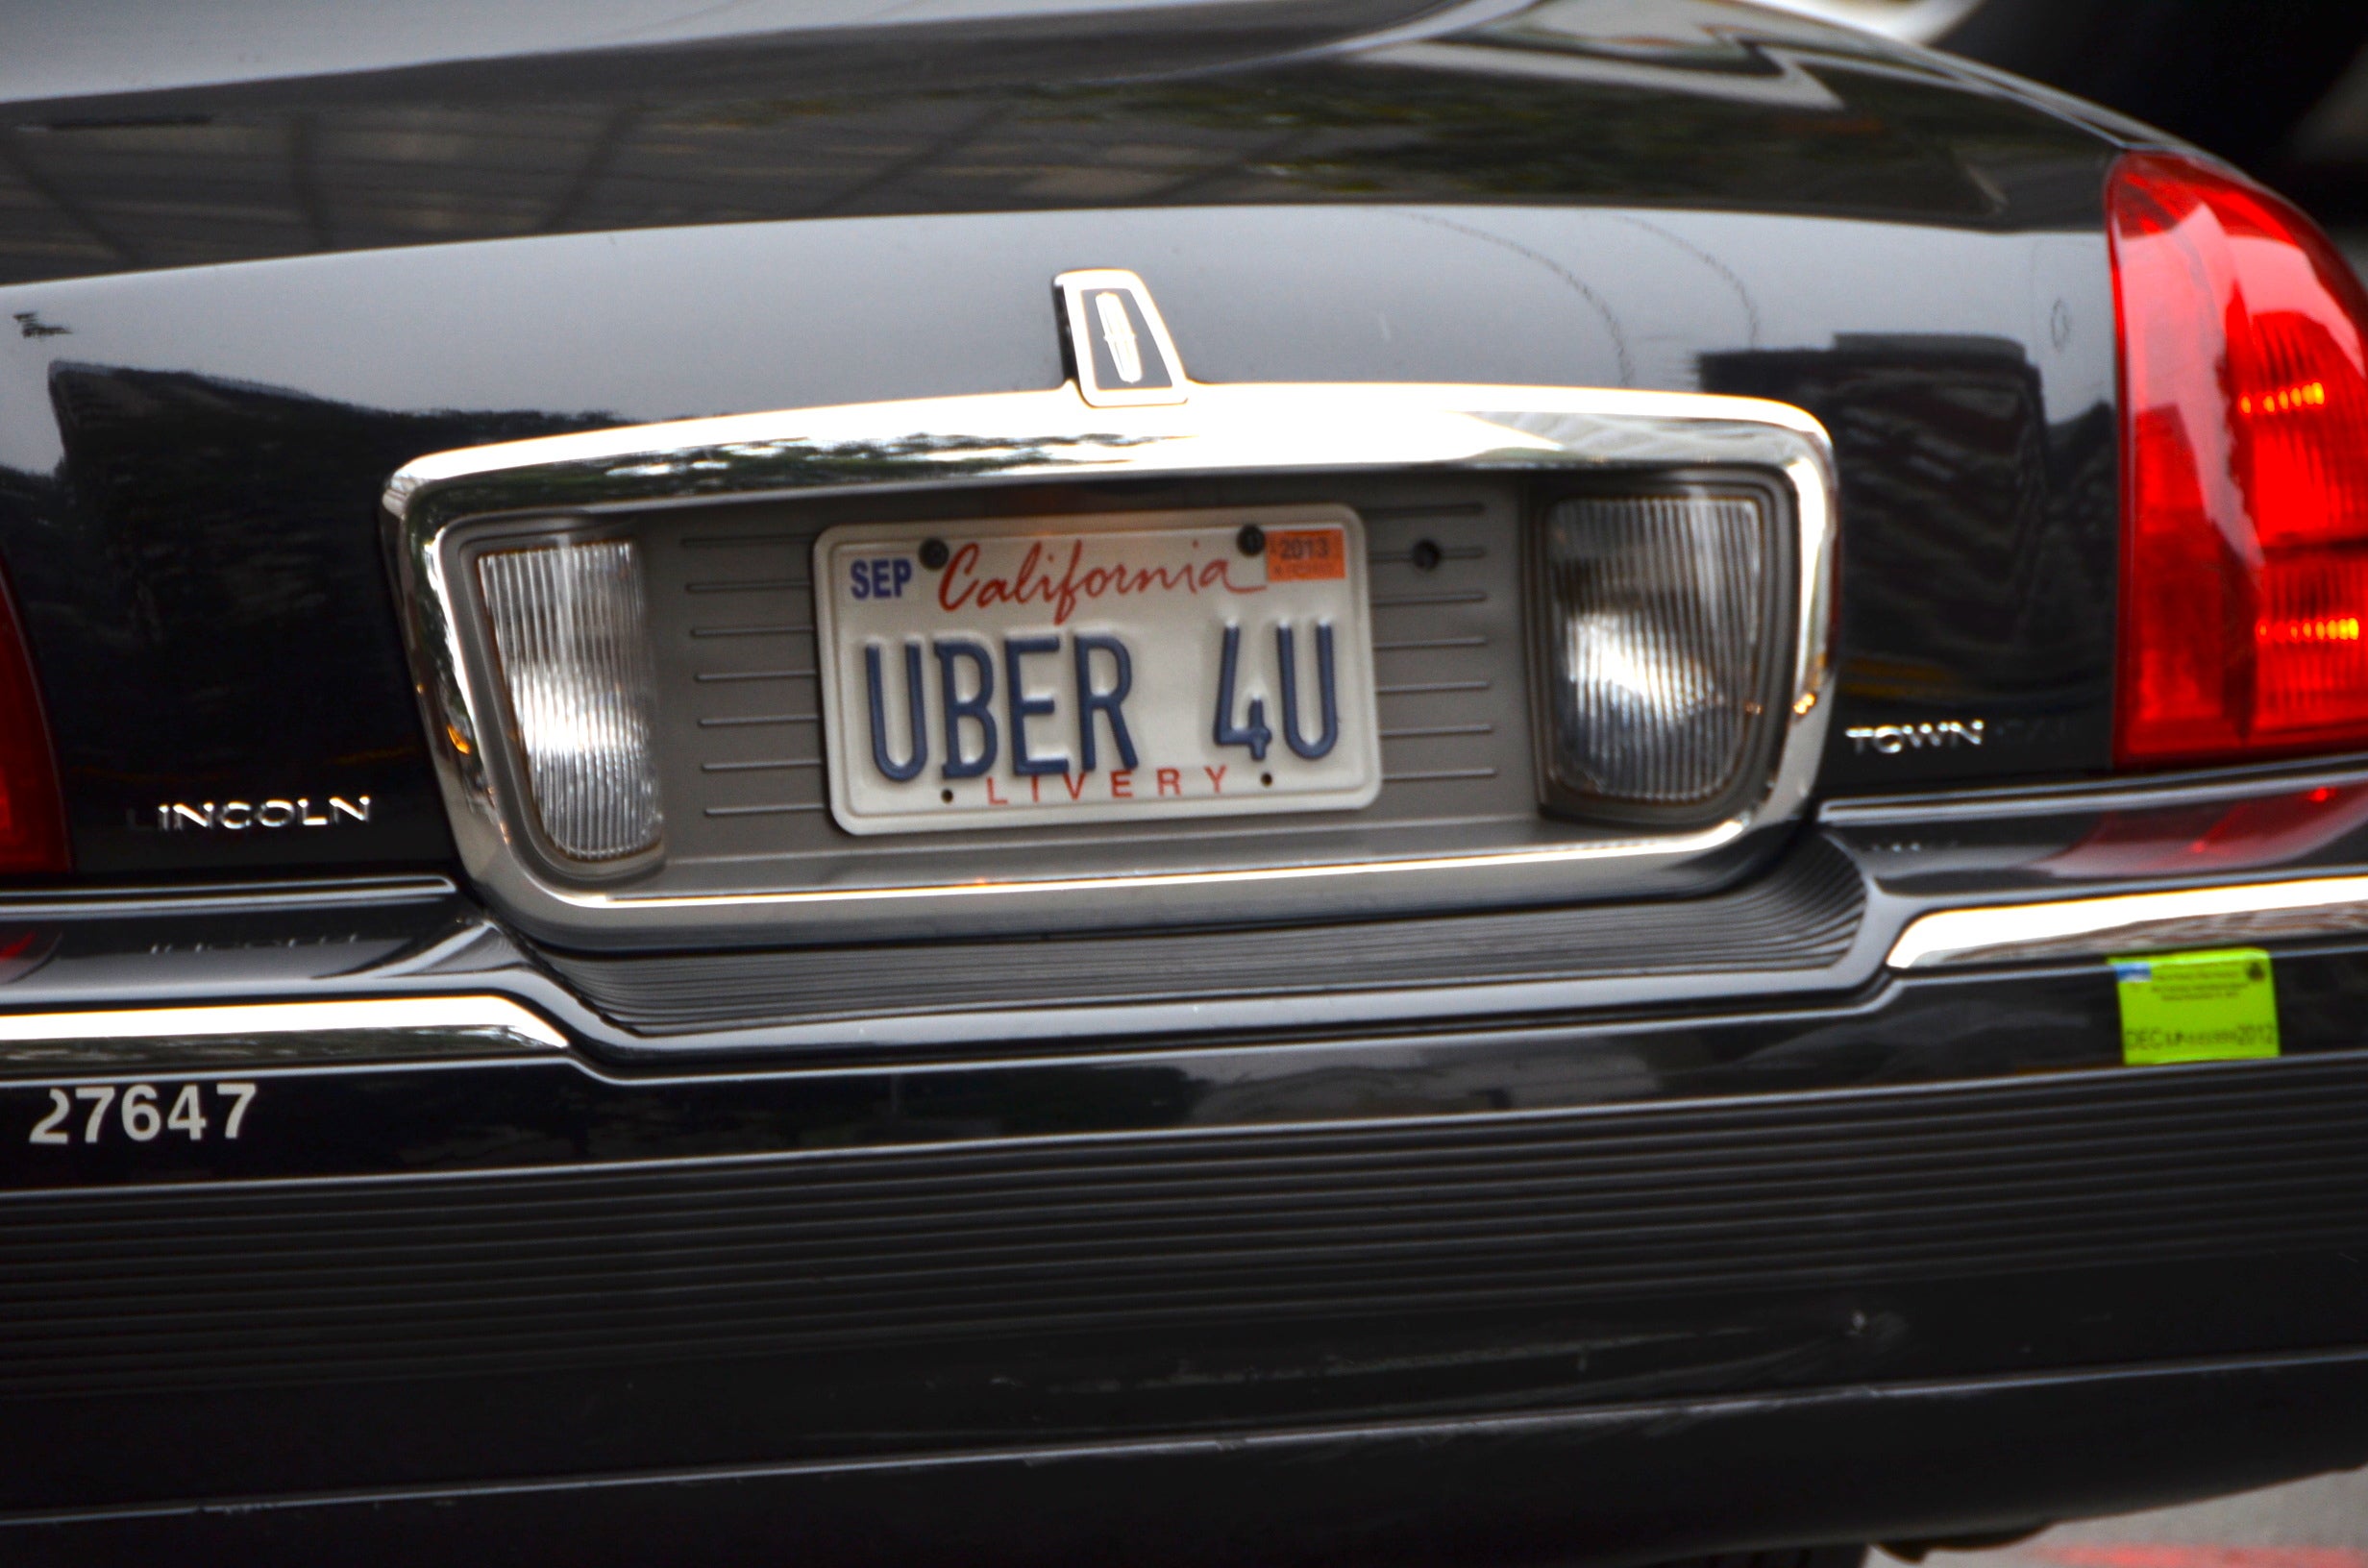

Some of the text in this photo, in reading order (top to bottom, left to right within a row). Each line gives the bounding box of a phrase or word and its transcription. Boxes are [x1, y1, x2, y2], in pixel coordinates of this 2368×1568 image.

[1279, 537, 1329, 559] 2013
[850, 558, 912, 601] SEP
[937, 539, 1268, 625] California
[865, 624, 1339, 784] UBER 4U
[1845, 721, 1984, 753] TOWN
[986, 765, 1227, 806] LIVERY
[29, 1083, 258, 1145] 27647
